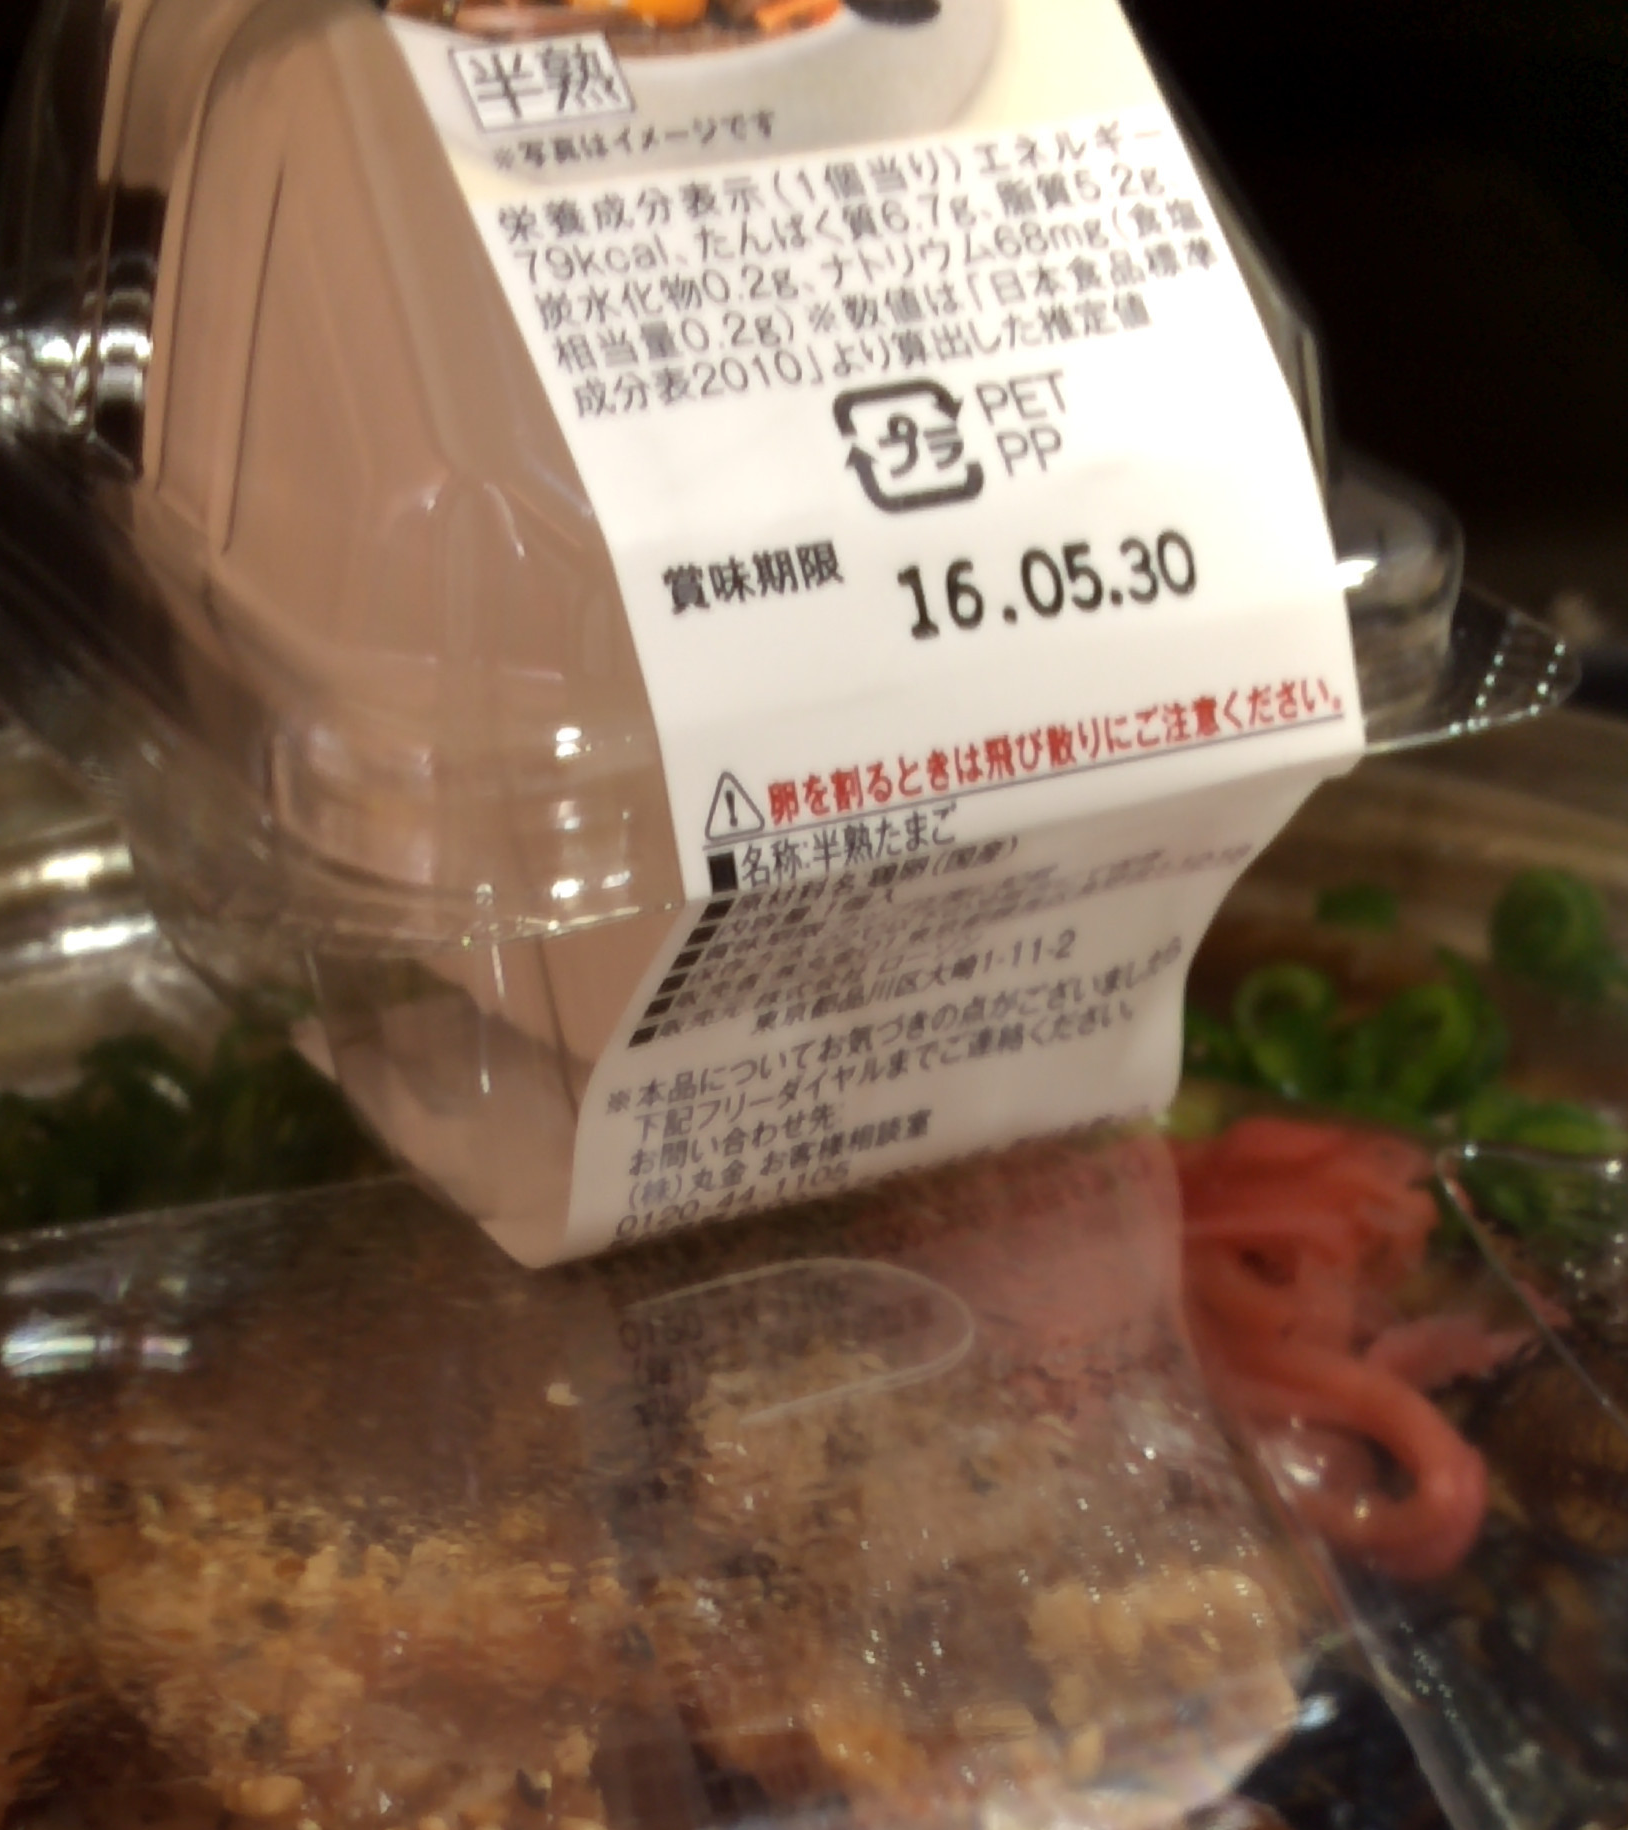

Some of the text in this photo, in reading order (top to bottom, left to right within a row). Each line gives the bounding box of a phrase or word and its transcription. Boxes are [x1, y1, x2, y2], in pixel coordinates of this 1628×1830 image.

[469, 42, 622, 118] 半熟
[977, 368, 1068, 426] PET
[994, 428, 1066, 477] PP
[662, 530, 1200, 641] 賞味期限 16.05.30
[767, 676, 1346, 825] 卵を割るときは飛び散りにご注意ください。
